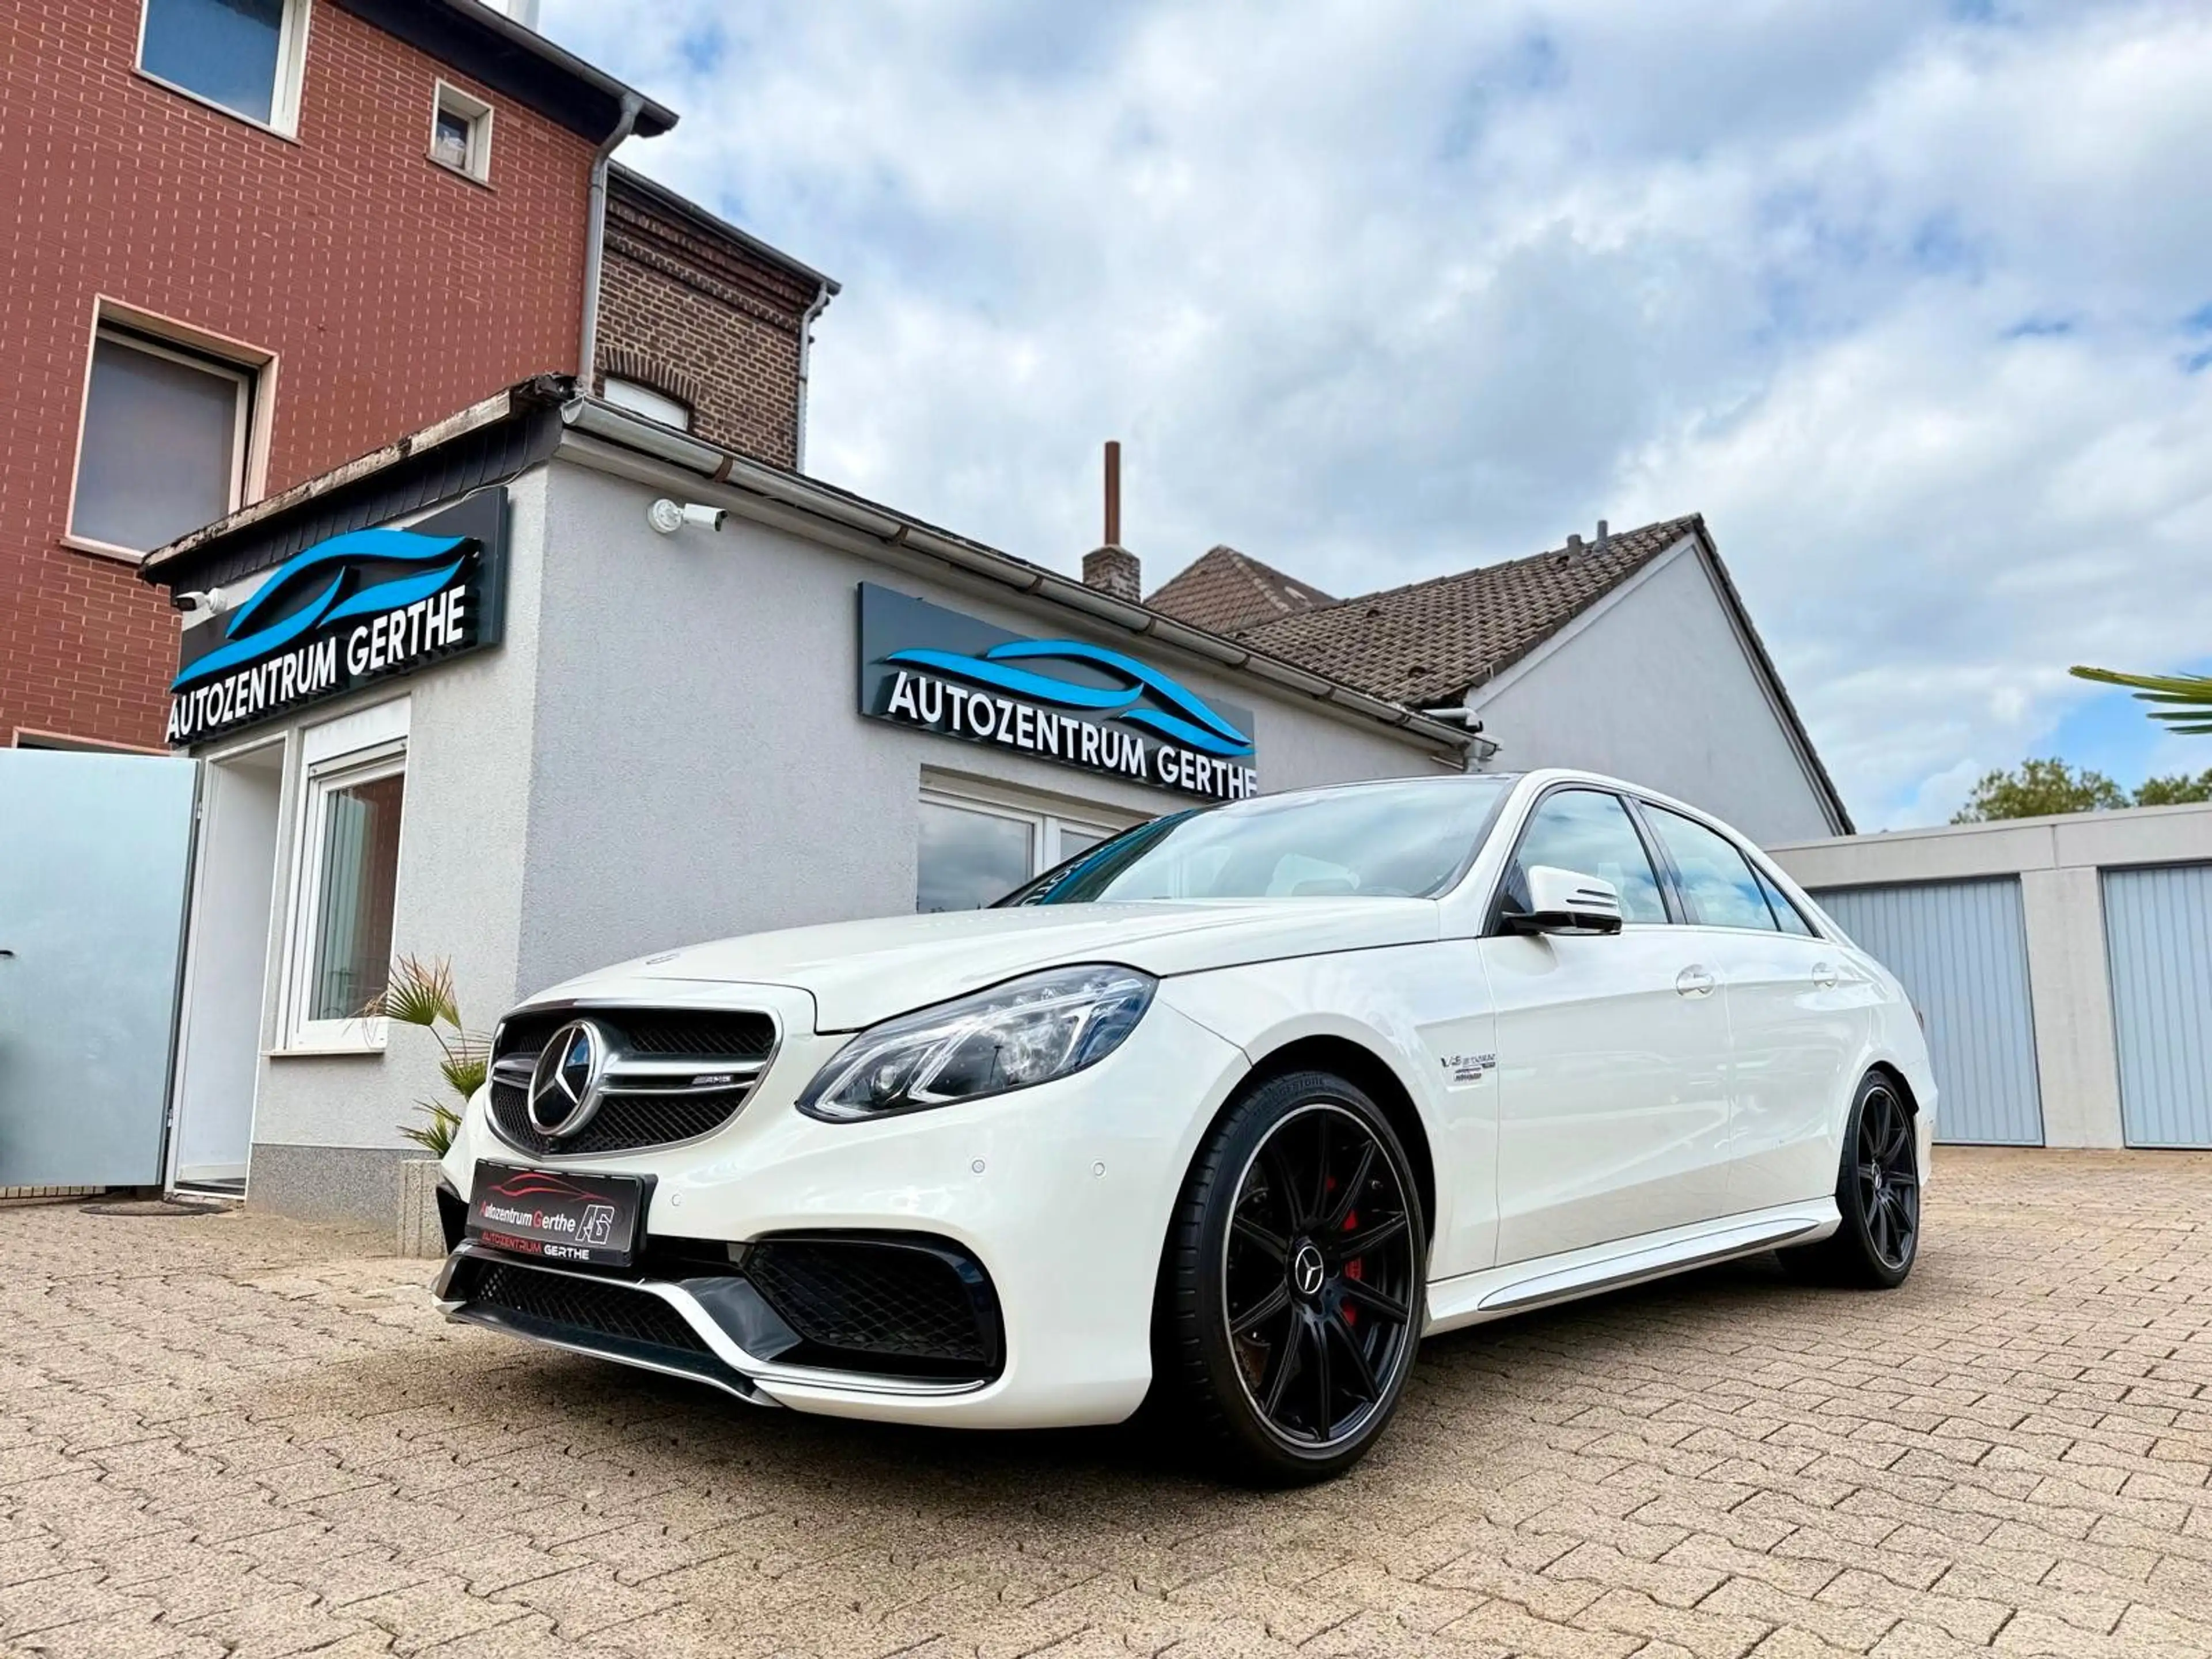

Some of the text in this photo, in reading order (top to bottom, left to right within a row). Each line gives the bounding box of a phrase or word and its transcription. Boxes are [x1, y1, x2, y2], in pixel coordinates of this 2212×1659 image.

[164, 585, 466, 743] AUTOZENTRUM GERTHE
[888, 671, 1257, 799] AUTOZENTRUM GERTHE
[480, 1200, 576, 1233] Autozentrum Gerthe
[483, 1231, 590, 1260] AUTOZENTRUM GERTHE
